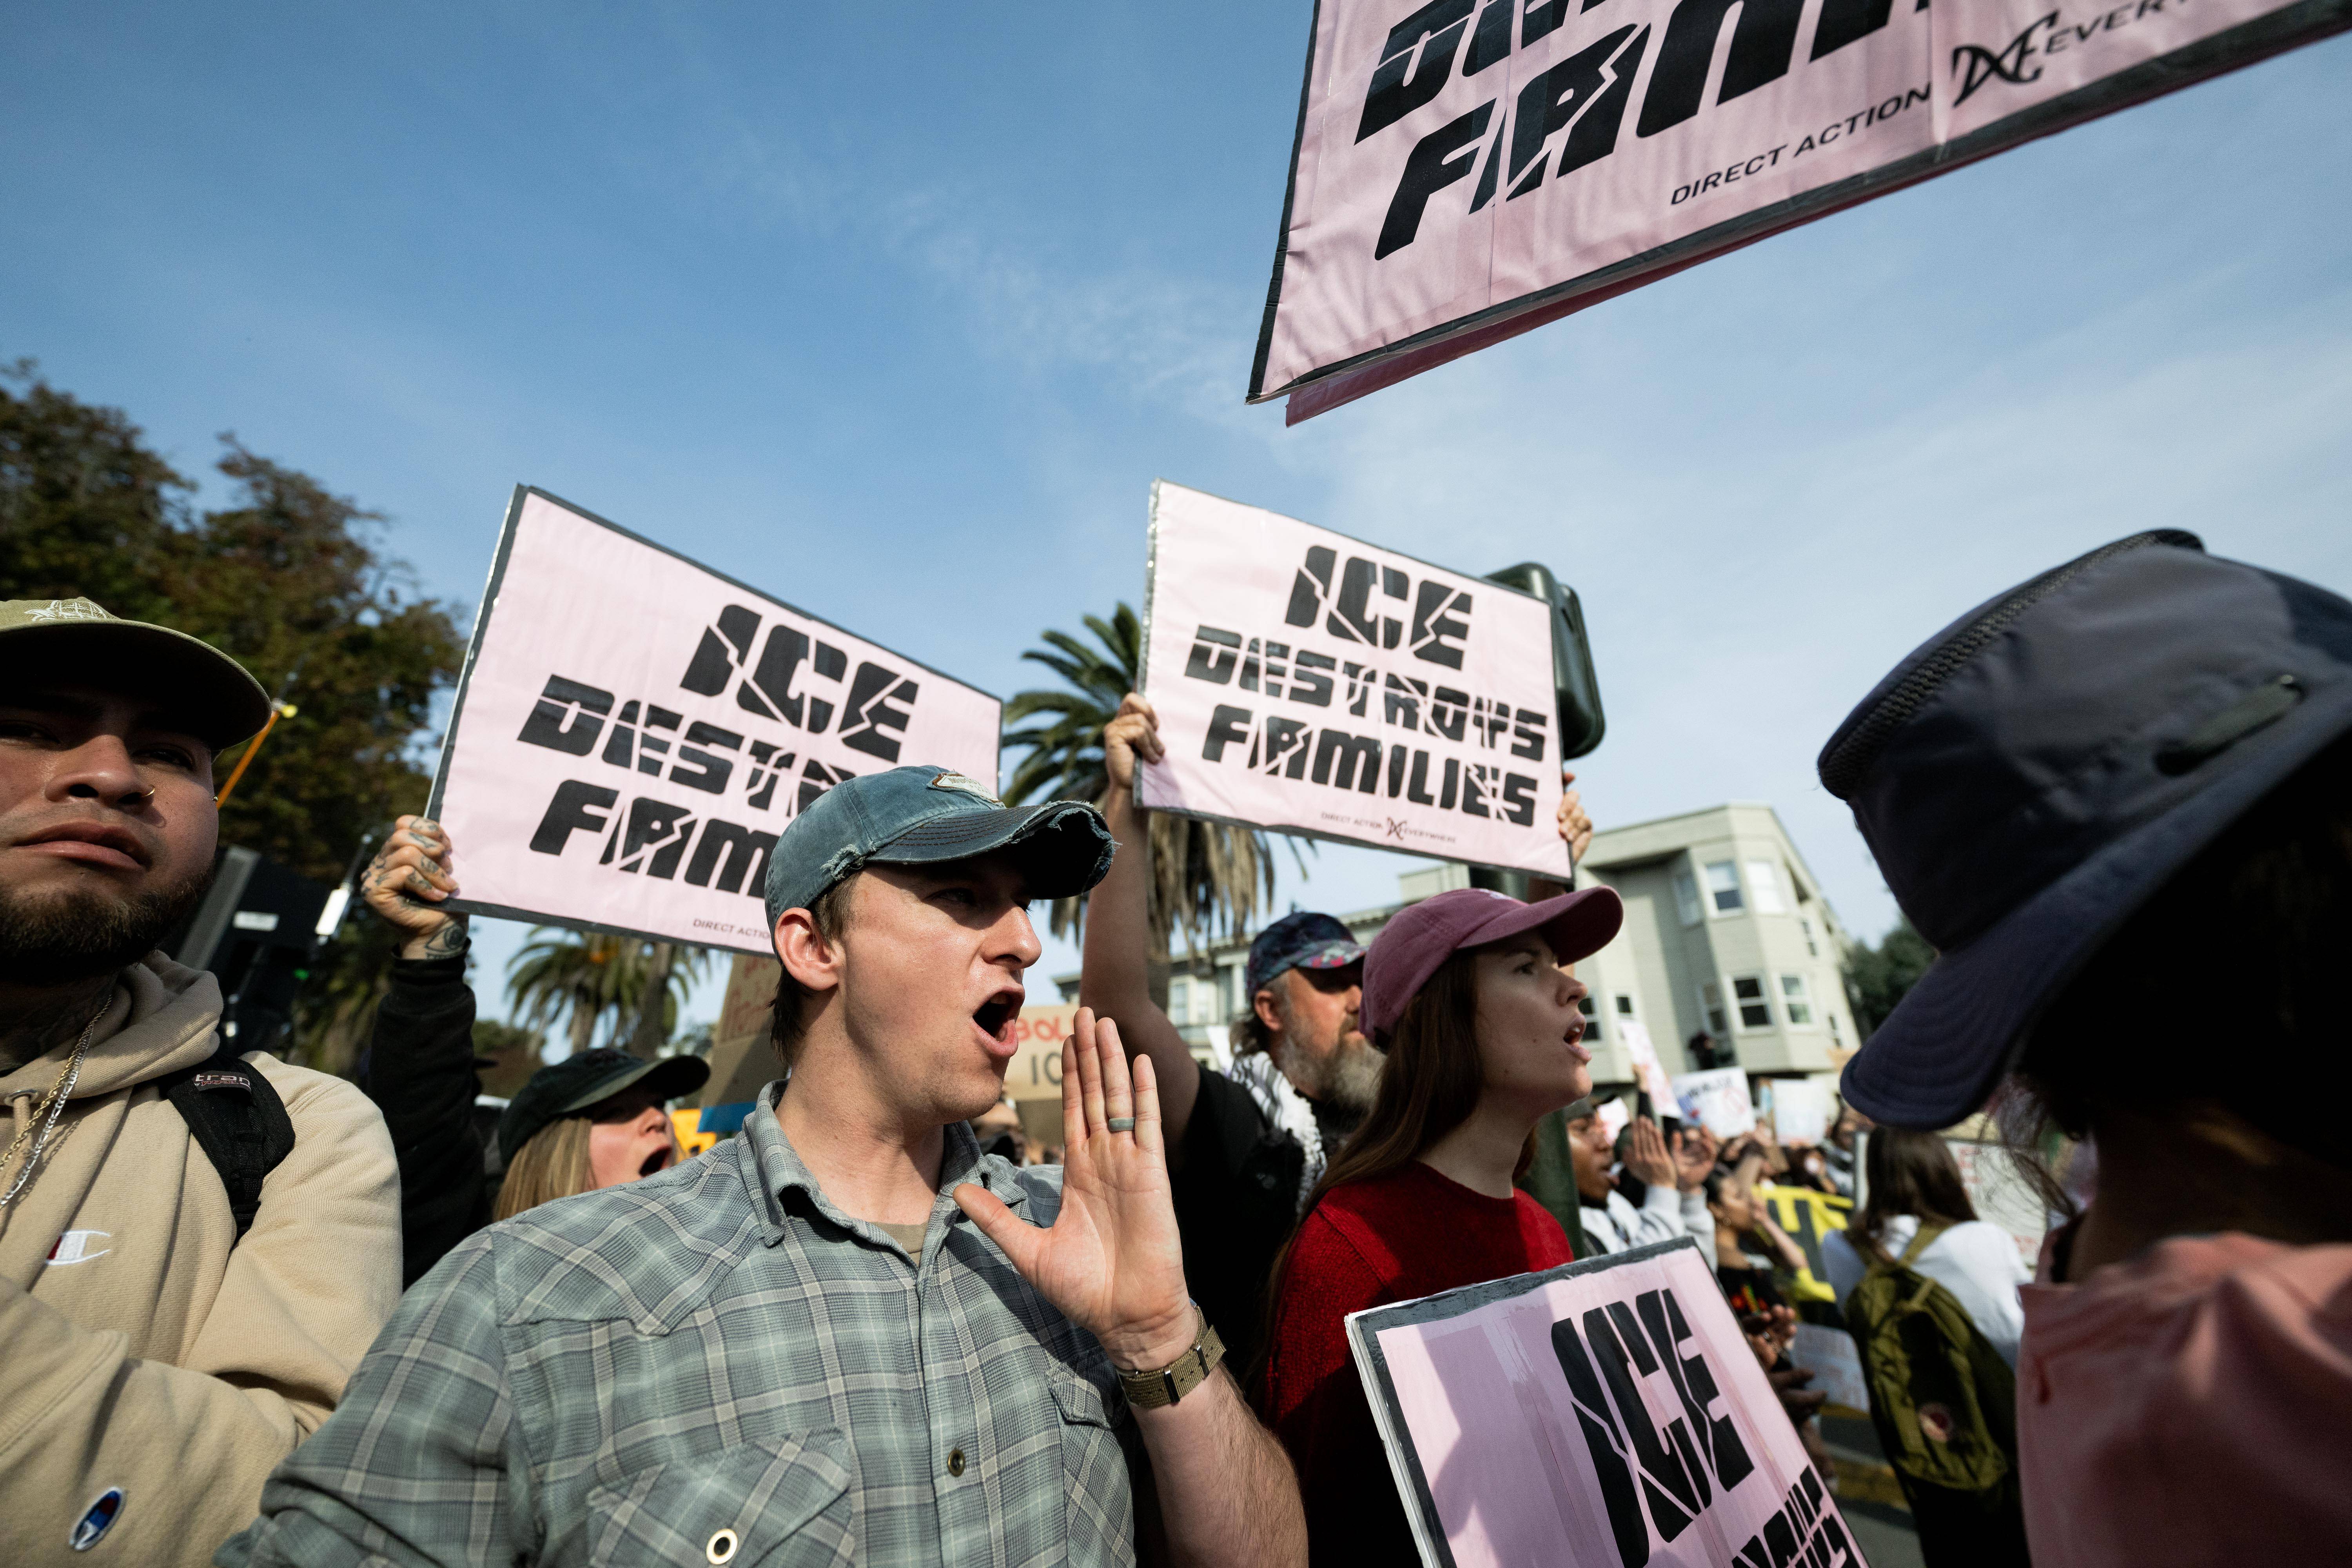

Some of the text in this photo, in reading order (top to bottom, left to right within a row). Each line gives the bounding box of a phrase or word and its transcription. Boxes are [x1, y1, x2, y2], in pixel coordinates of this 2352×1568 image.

[1671, 144, 1788, 205] DIRECT
[1794, 82, 1931, 158] ACTION
[2045, 0, 2186, 55] EVER
[1285, 545, 1472, 671] ICE
[679, 604, 920, 763] ICE
[1184, 624, 1547, 762] DESTROYS
[1202, 704, 1539, 827] FAMILIES
[693, 919, 735, 933] DIRECT
[1551, 1289, 1755, 1568] ICE
